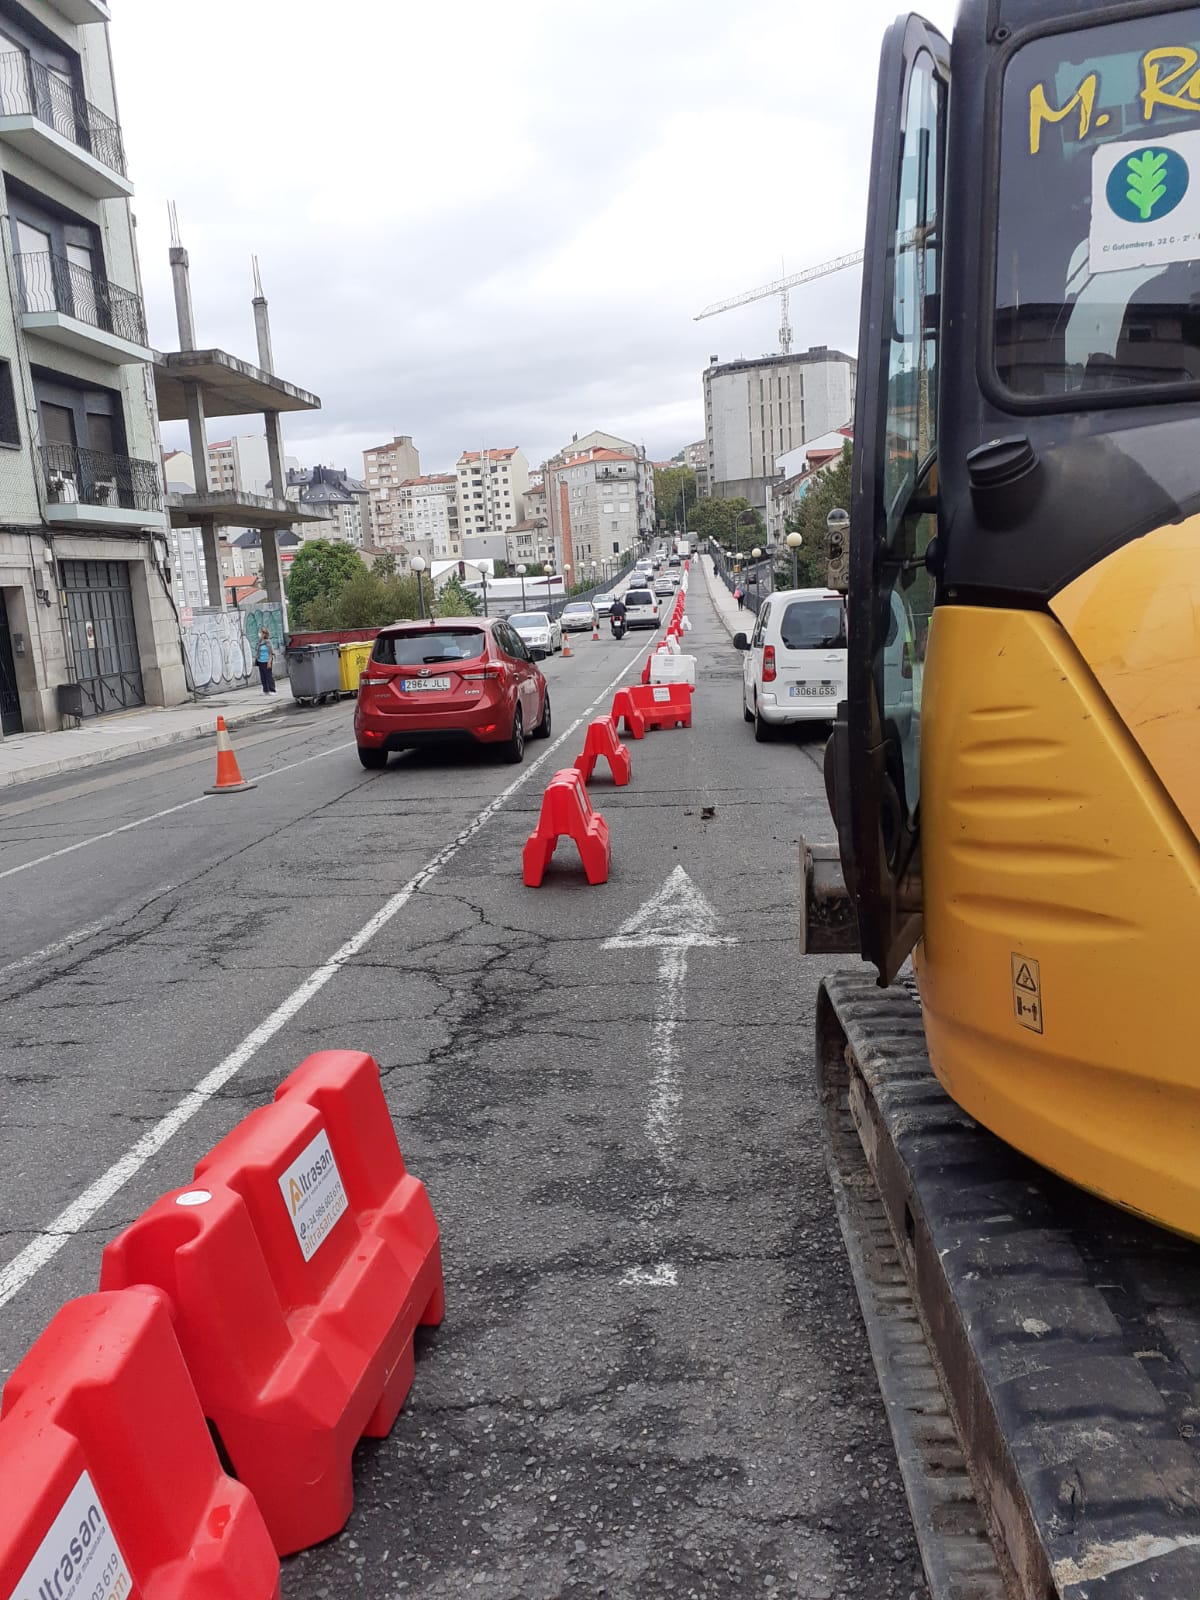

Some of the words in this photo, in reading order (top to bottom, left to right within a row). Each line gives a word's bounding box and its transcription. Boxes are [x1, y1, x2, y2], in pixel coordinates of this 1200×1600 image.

[406, 680, 428, 690] 2964
[431, 679, 448, 688] JLL
[795, 687, 817, 696] 3068
[819, 687, 836, 696] GSS
[288, 1148, 333, 1217] Altrasan
[305, 1193, 346, 1255] altrasan.com
[37, 1504, 101, 1600] ltrasan
[102, 1552, 119, 1587] 619
